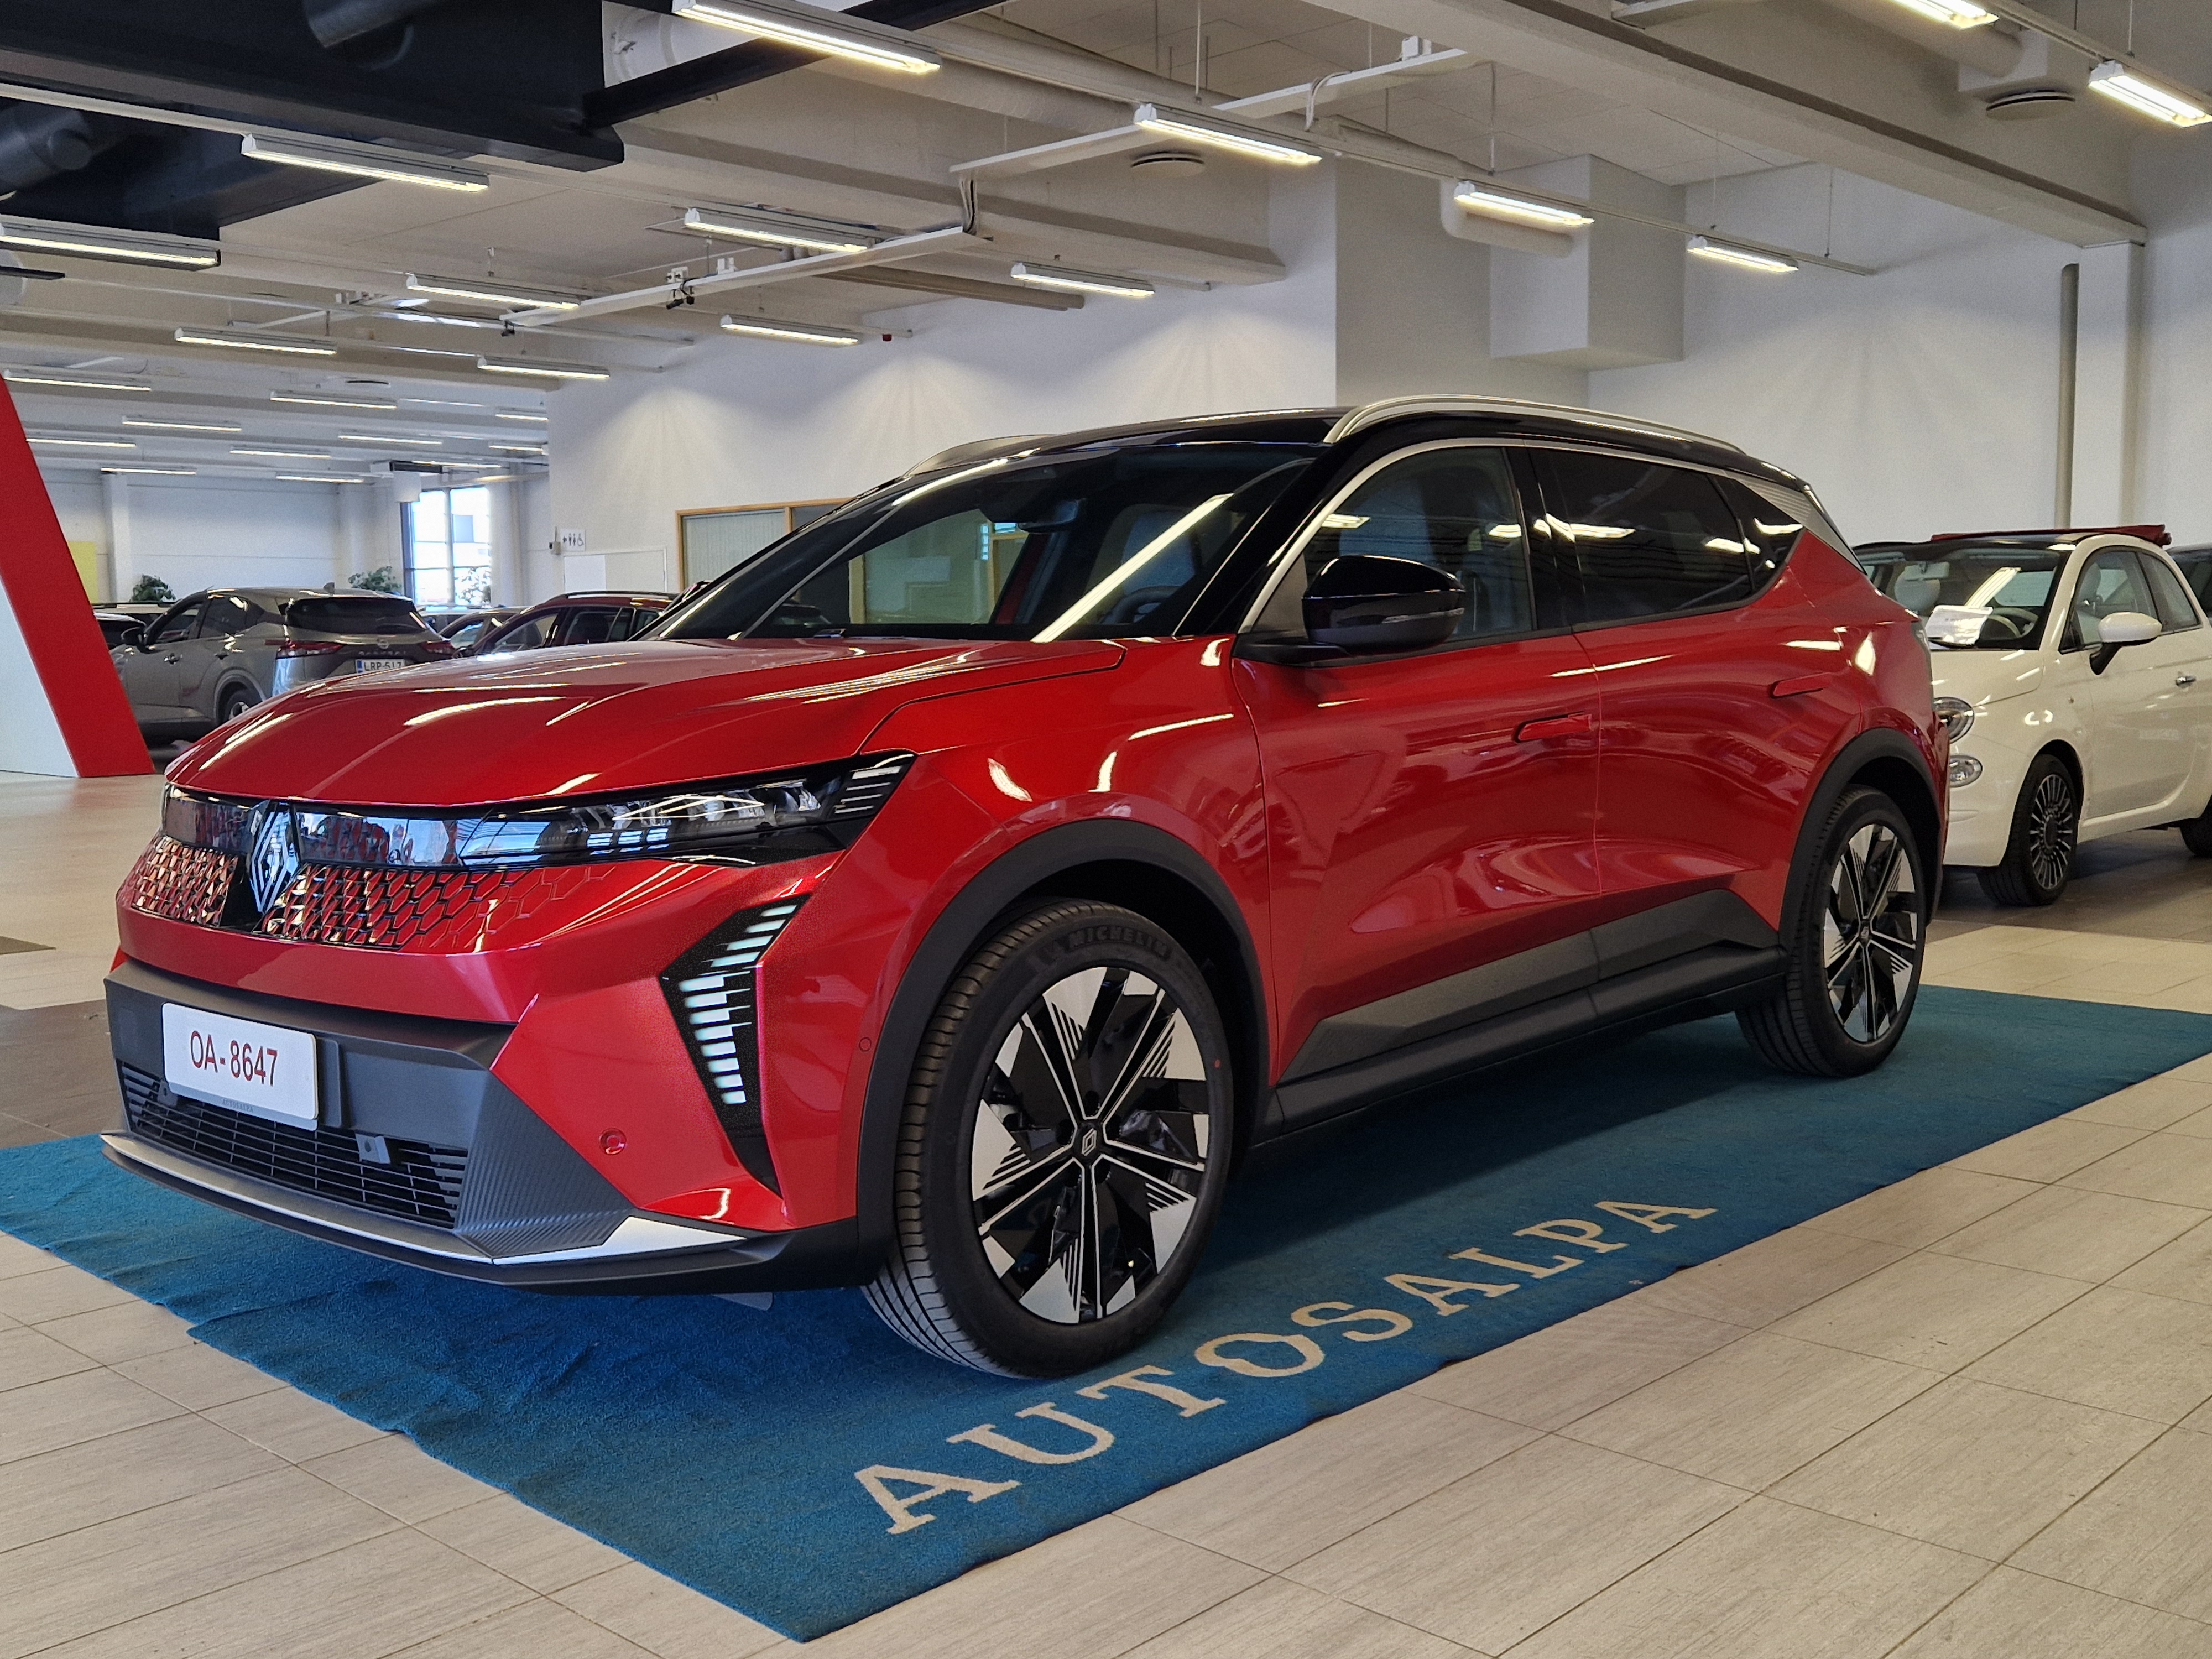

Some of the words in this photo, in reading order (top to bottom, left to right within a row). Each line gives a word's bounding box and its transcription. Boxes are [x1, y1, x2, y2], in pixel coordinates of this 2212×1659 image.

[1066, 925, 1169, 956] MICHELIN
[190, 1030, 278, 1087] OA-8647
[854, 1199, 1717, 1535] AUTOSALPA
